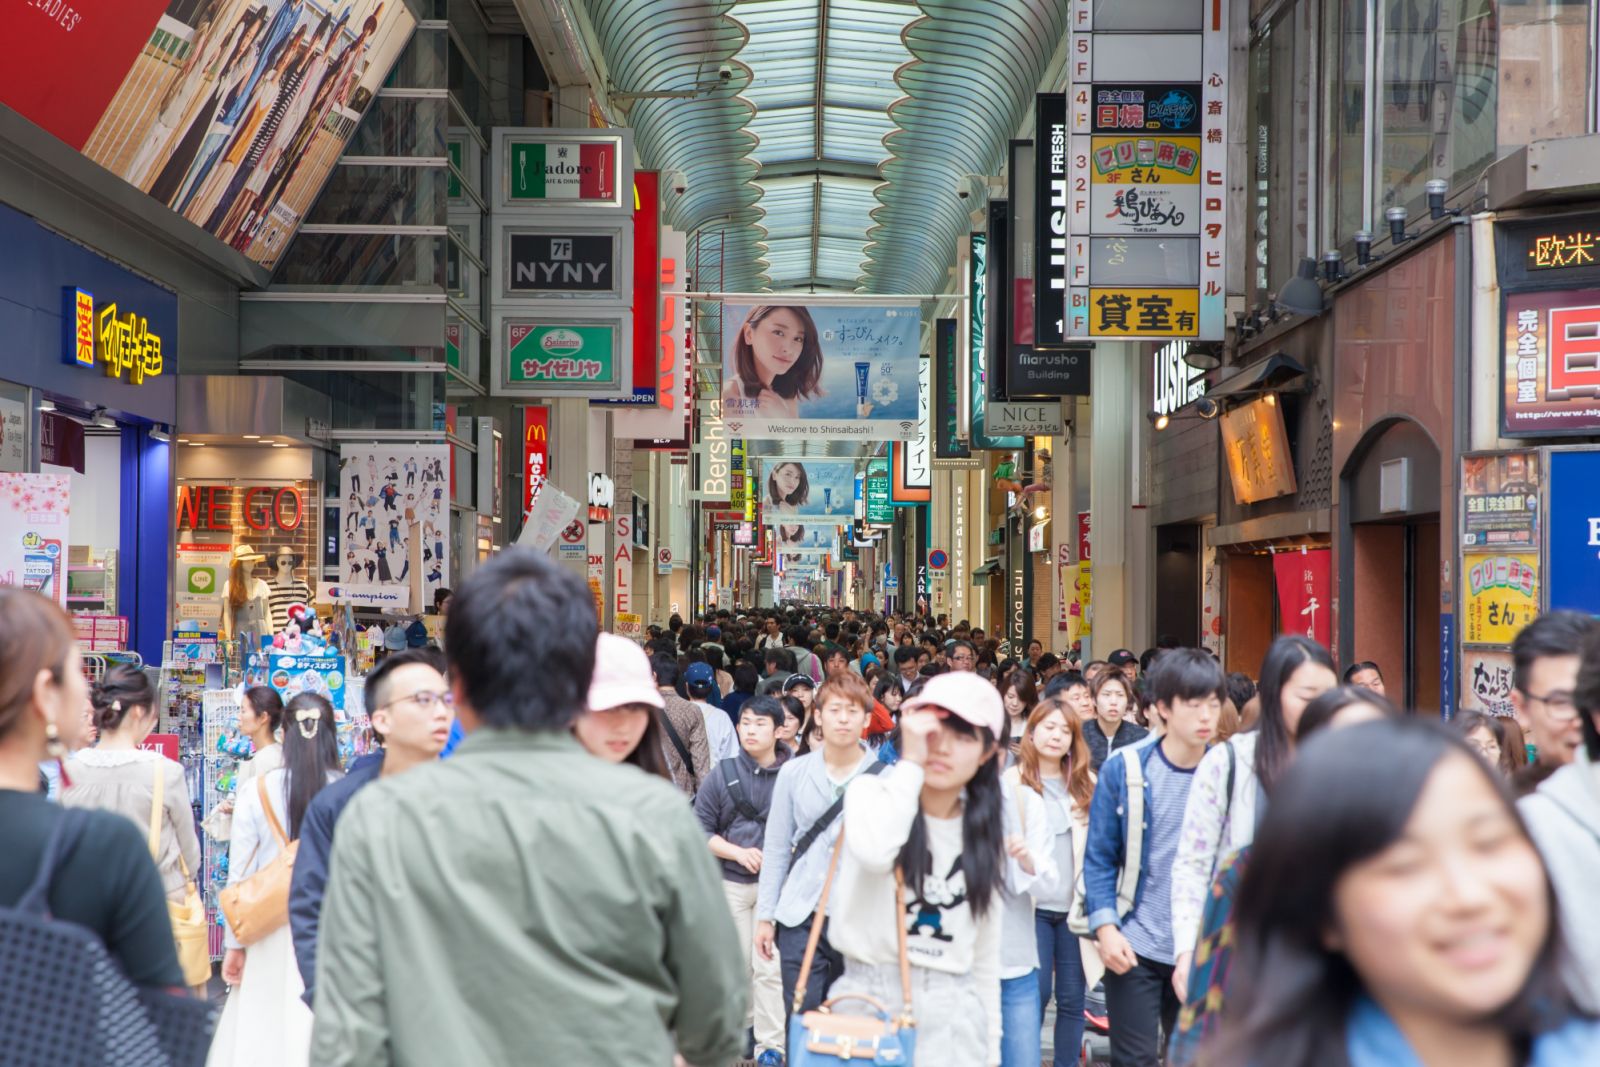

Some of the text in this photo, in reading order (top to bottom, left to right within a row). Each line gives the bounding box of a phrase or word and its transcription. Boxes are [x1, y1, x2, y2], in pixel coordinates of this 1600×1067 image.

[1098, 90, 1144, 103] 完全個室
[1097, 104, 1144, 128] 日焼
[1051, 124, 1065, 173] FRESH
[1131, 168, 1160, 184] さん
[553, 243, 570, 256] 7F
[516, 262, 607, 283] NYNY
[77, 296, 93, 362] 薬
[512, 328, 526, 337] 6F
[1019, 354, 1078, 365] Marusho
[1517, 309, 1538, 402] 完全個室
[523, 358, 601, 378] サイゼリヤ
[1027, 370, 1070, 380] Building
[1003, 407, 1047, 421] NICE
[767, 425, 807, 433] Welcome
[820, 425, 874, 434] Shinsaibashi!
[703, 399, 727, 496] Bershka
[244, 486, 303, 531] GO
[615, 517, 631, 612] SALE
[1488, 601, 1515, 625] さん
